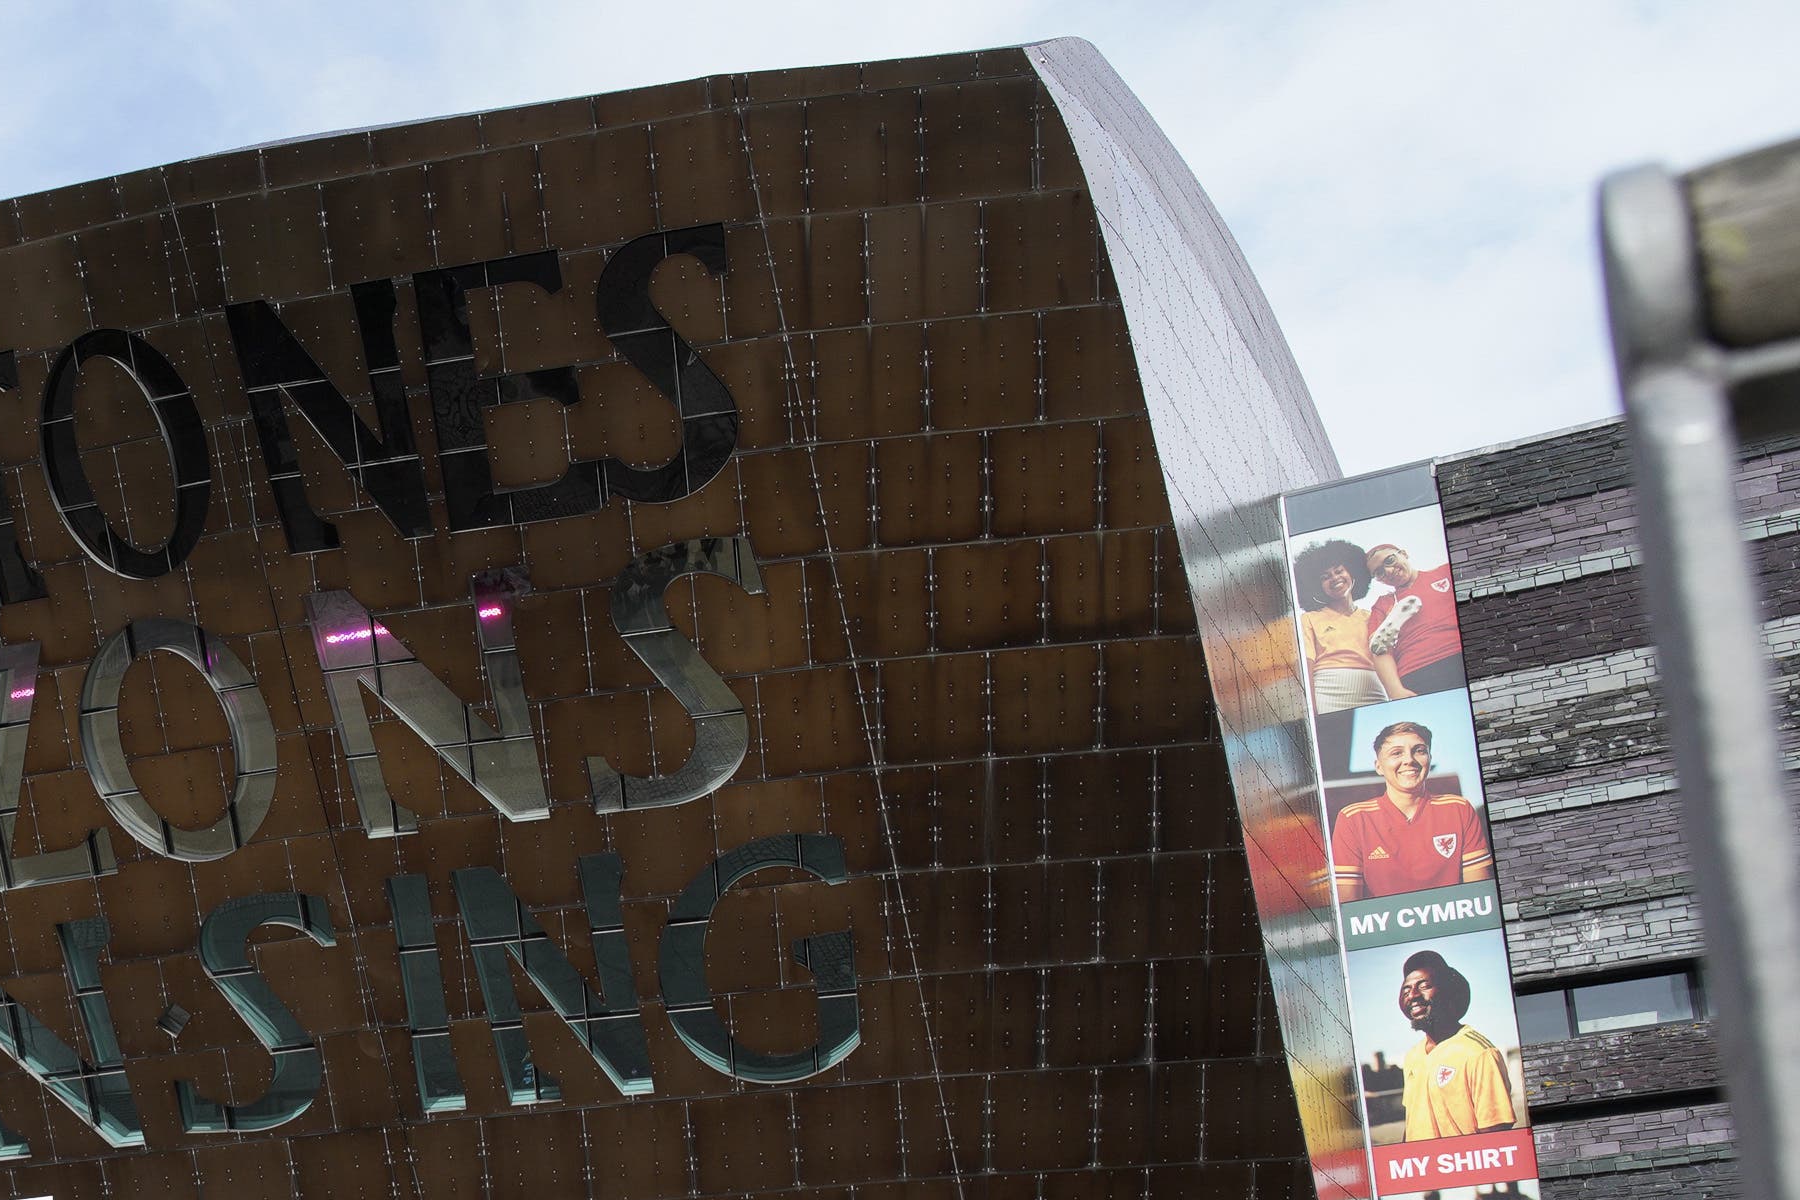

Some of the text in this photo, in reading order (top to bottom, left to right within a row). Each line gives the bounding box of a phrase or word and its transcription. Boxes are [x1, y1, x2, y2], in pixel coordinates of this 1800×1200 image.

[1350, 895, 1493, 936] MY CYMRU
[174, 831, 861, 1135] SING
[1388, 1145, 1518, 1180] MY SHIRT
